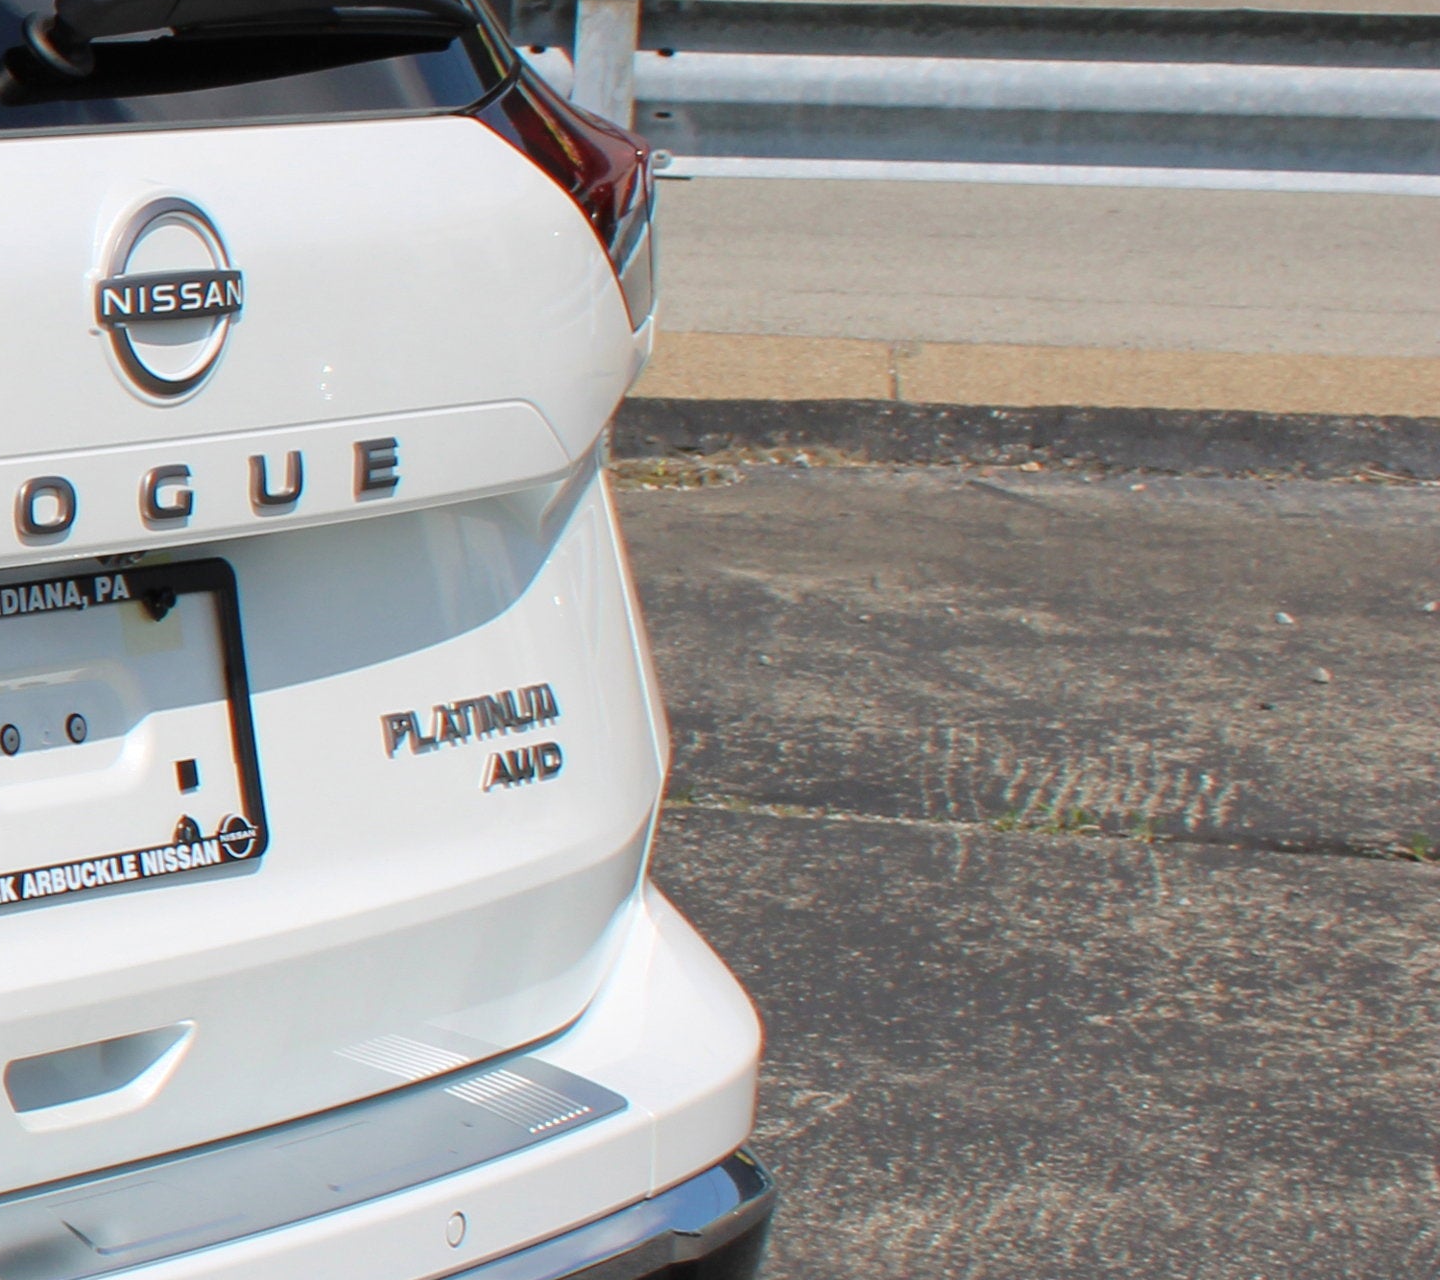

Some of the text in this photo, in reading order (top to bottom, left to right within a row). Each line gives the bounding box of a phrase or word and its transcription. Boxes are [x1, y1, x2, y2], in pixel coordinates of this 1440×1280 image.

[102, 279, 242, 316] NISSAN
[94, 573, 130, 602] PA
[379, 682, 560, 760] PLATINUM
[481, 741, 563, 793] AWD
[220, 826, 258, 843] NISSAN
[21, 853, 139, 901] ARBUCKLE
[140, 838, 221, 877] NISSAN
